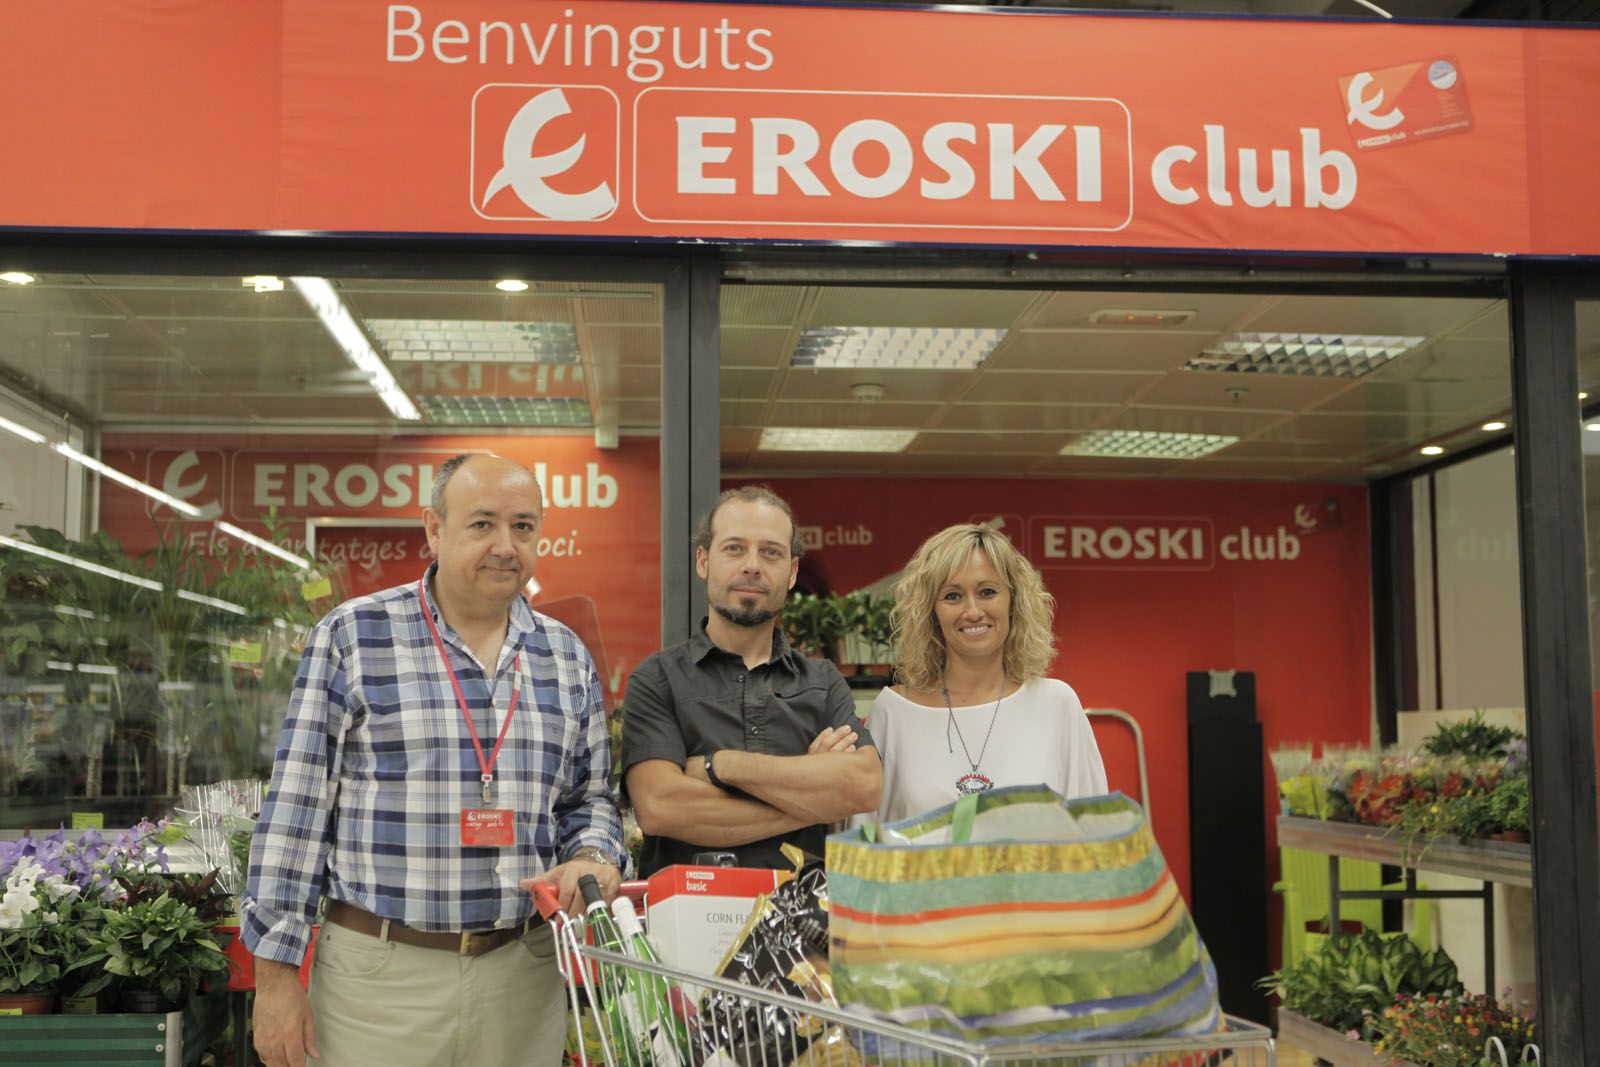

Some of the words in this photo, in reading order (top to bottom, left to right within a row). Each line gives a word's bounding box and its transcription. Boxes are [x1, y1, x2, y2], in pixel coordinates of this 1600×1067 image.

[386, 4, 775, 83] Benvinguts
[675, 116, 1102, 203] EROSKI
[1151, 124, 1358, 211] club
[534, 462, 619, 508] lub
[535, 529, 583, 558] oci.
[824, 524, 873, 546] club
[1043, 525, 1204, 560] EROSKI
[1219, 526, 1300, 561] club
[686, 880, 708, 892] basic
[706, 912, 733, 924] CORN
